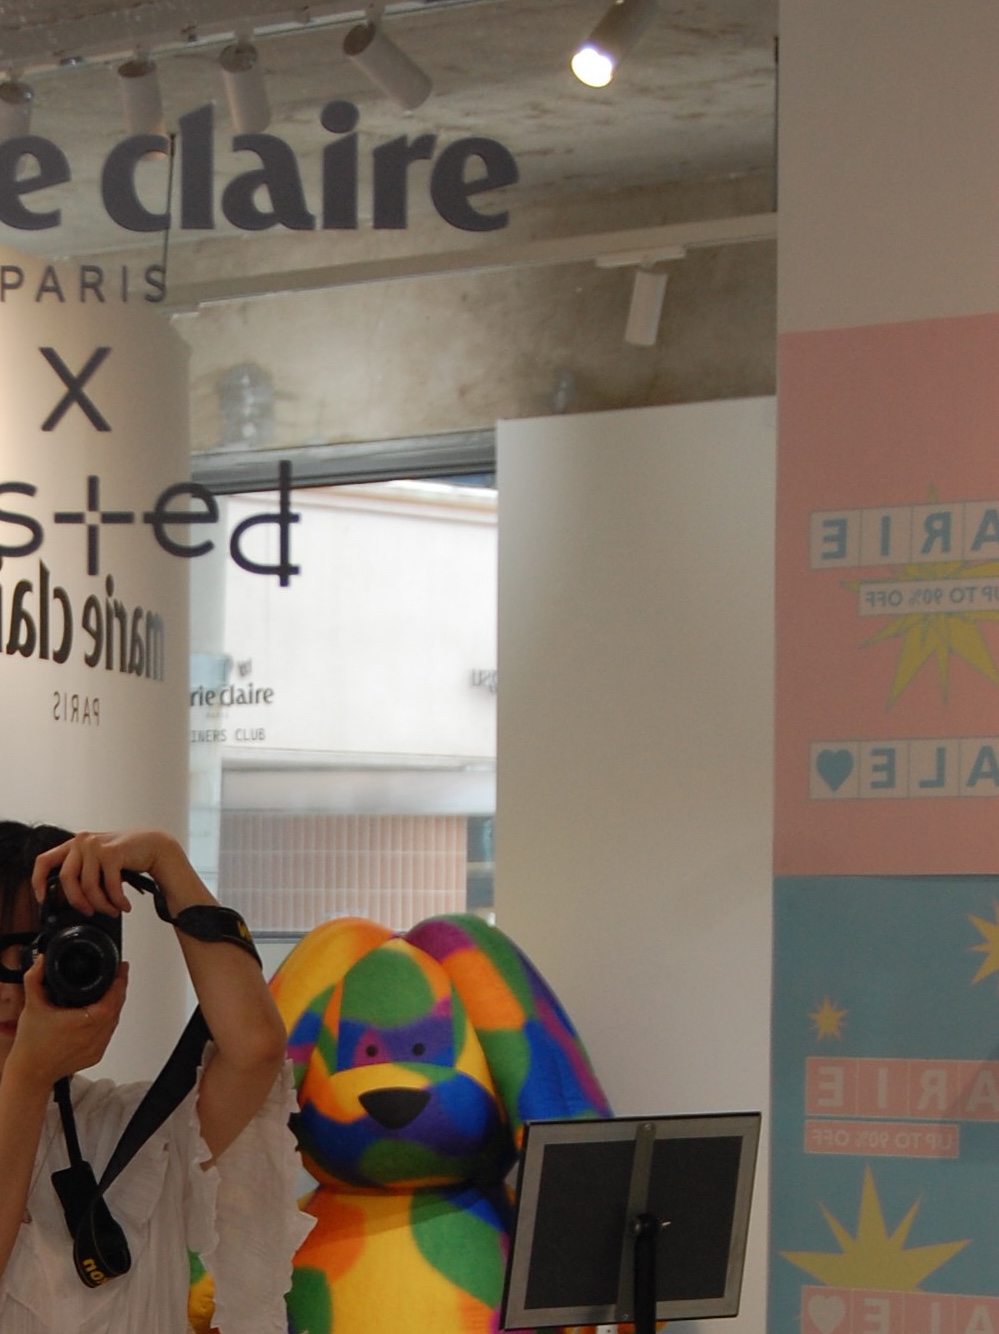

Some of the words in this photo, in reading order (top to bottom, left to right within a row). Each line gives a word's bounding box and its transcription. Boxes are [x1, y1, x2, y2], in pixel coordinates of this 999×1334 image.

[101, 101, 520, 232] claire
[0, 265, 168, 303] PARIS
[219, 682, 275, 706] claire
[234, 727, 266, 742] CLUB
